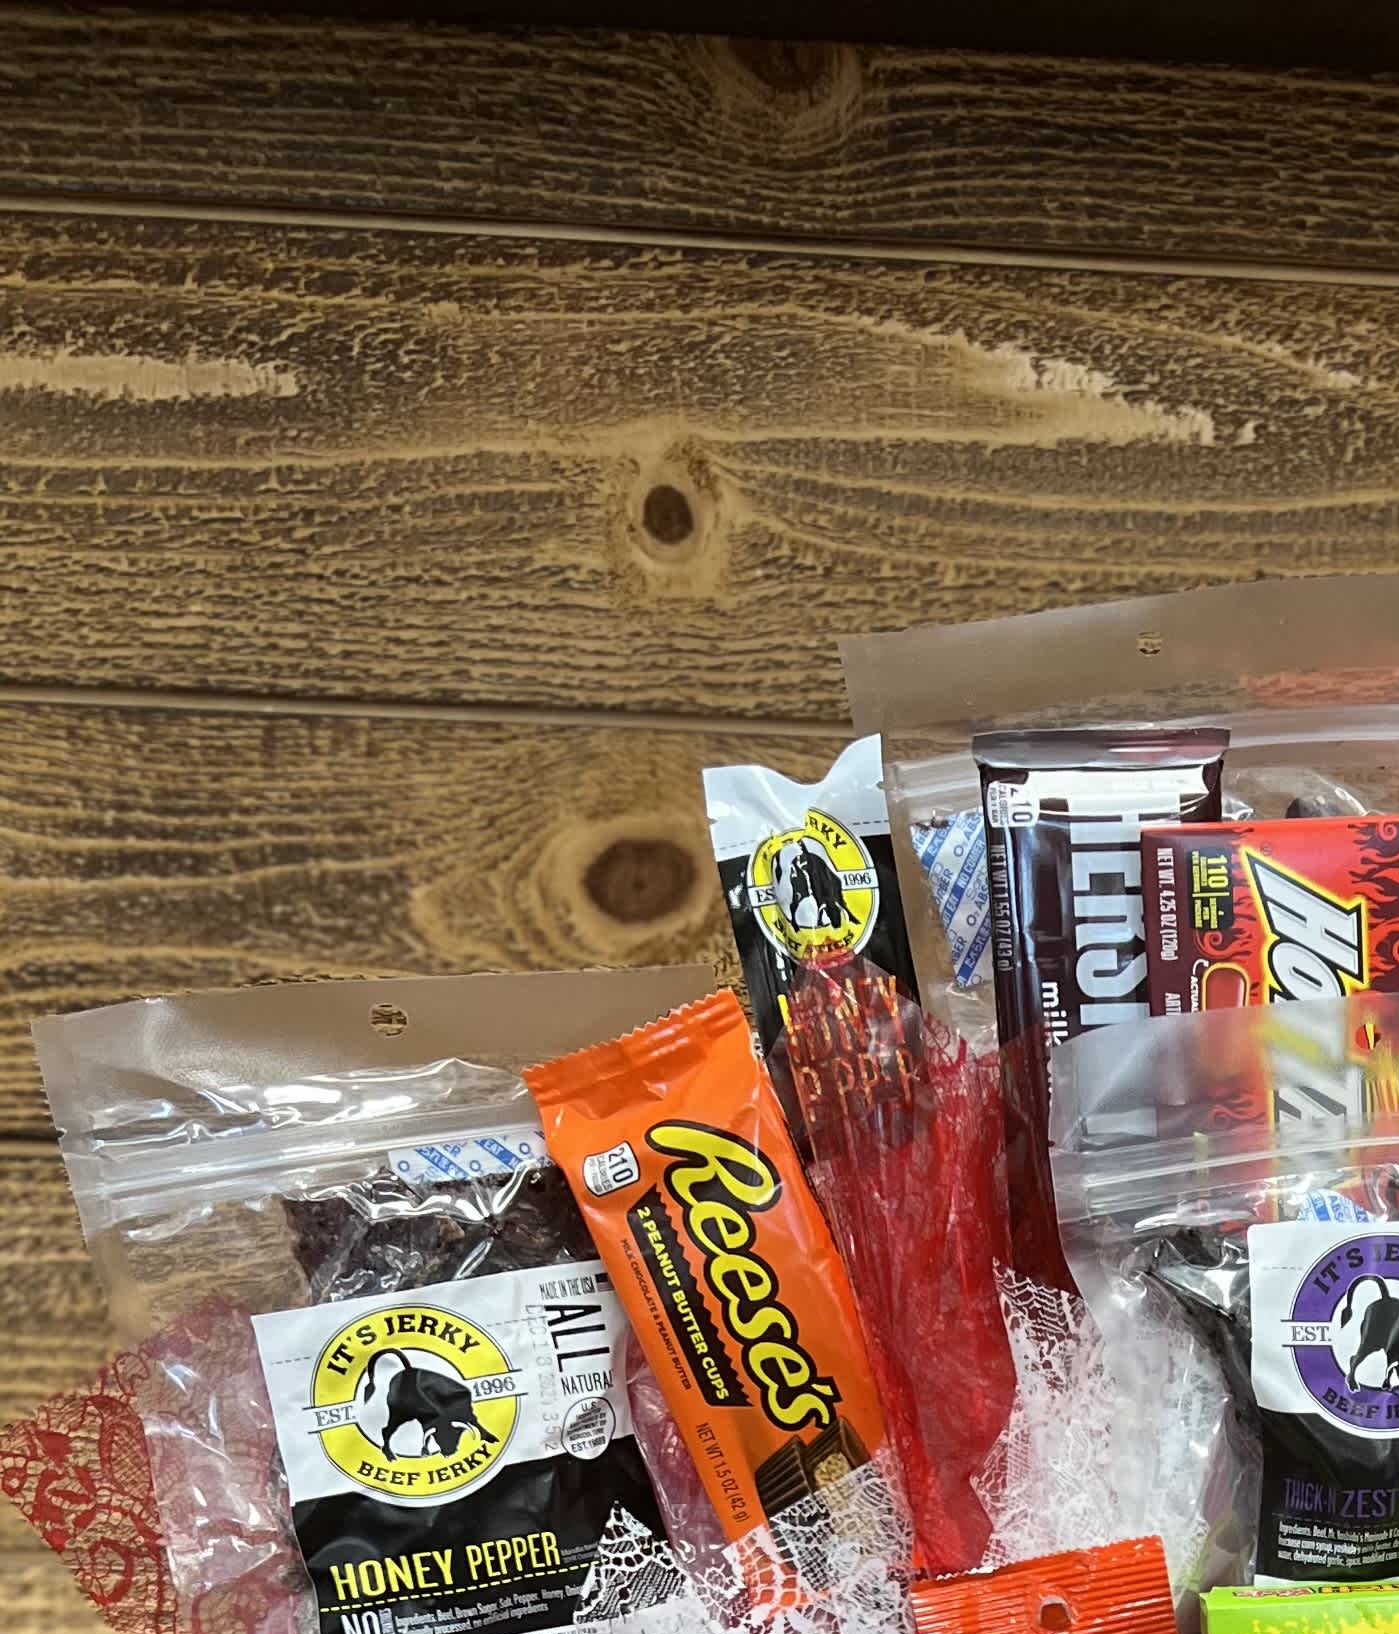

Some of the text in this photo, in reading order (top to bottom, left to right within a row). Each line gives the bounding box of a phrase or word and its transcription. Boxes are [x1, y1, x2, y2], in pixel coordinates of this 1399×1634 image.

[842, 872, 872, 886] 1996
[1207, 855, 1228, 888] 110
[608, 1146, 634, 1184] 210
[648, 1123, 837, 1428] Reese's
[1313, 1248, 1365, 1294] IT'S
[637, 1206, 729, 1400] 2 PEANUT BUTTER CUPS
[326, 1313, 480, 1377] IT'S JERKY
[544, 1305, 610, 1373] ALL
[656, 1320, 677, 1356] PEANUT
[672, 1356, 692, 1391] BUTTER
[1291, 1325, 1333, 1342] EST.
[314, 1375, 516, 1427] EST. 1996
[1322, 1386, 1378, 1420] BEEF
[696, 1422, 715, 1443] NET
[705, 1443, 724, 1460] WT
[356, 1442, 496, 1486] BEEF JERKY
[721, 1479, 739, 1494] OZ
[329, 1531, 561, 1601] HONEY PEPPER
